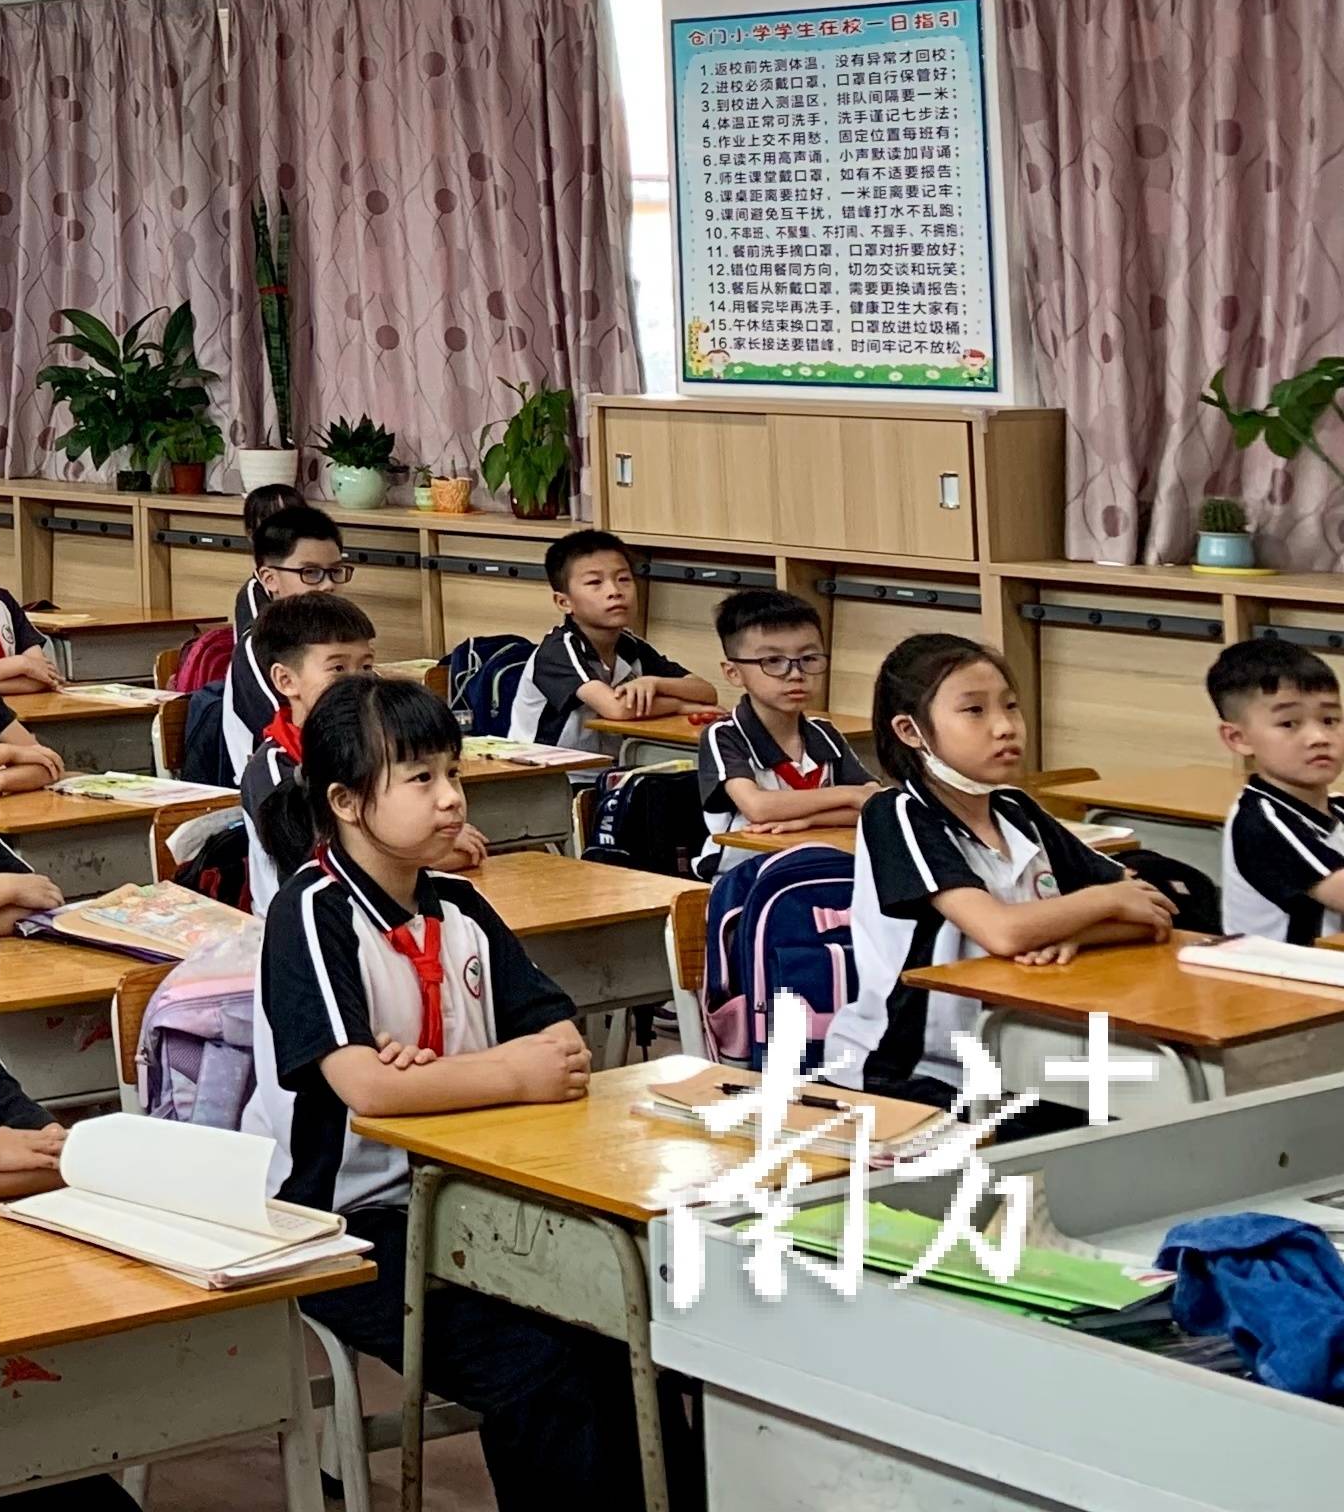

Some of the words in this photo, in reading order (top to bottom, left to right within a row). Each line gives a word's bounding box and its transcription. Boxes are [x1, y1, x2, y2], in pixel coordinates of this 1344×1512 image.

[687, 10, 960, 46] 仓门小学学生在校一日指引
